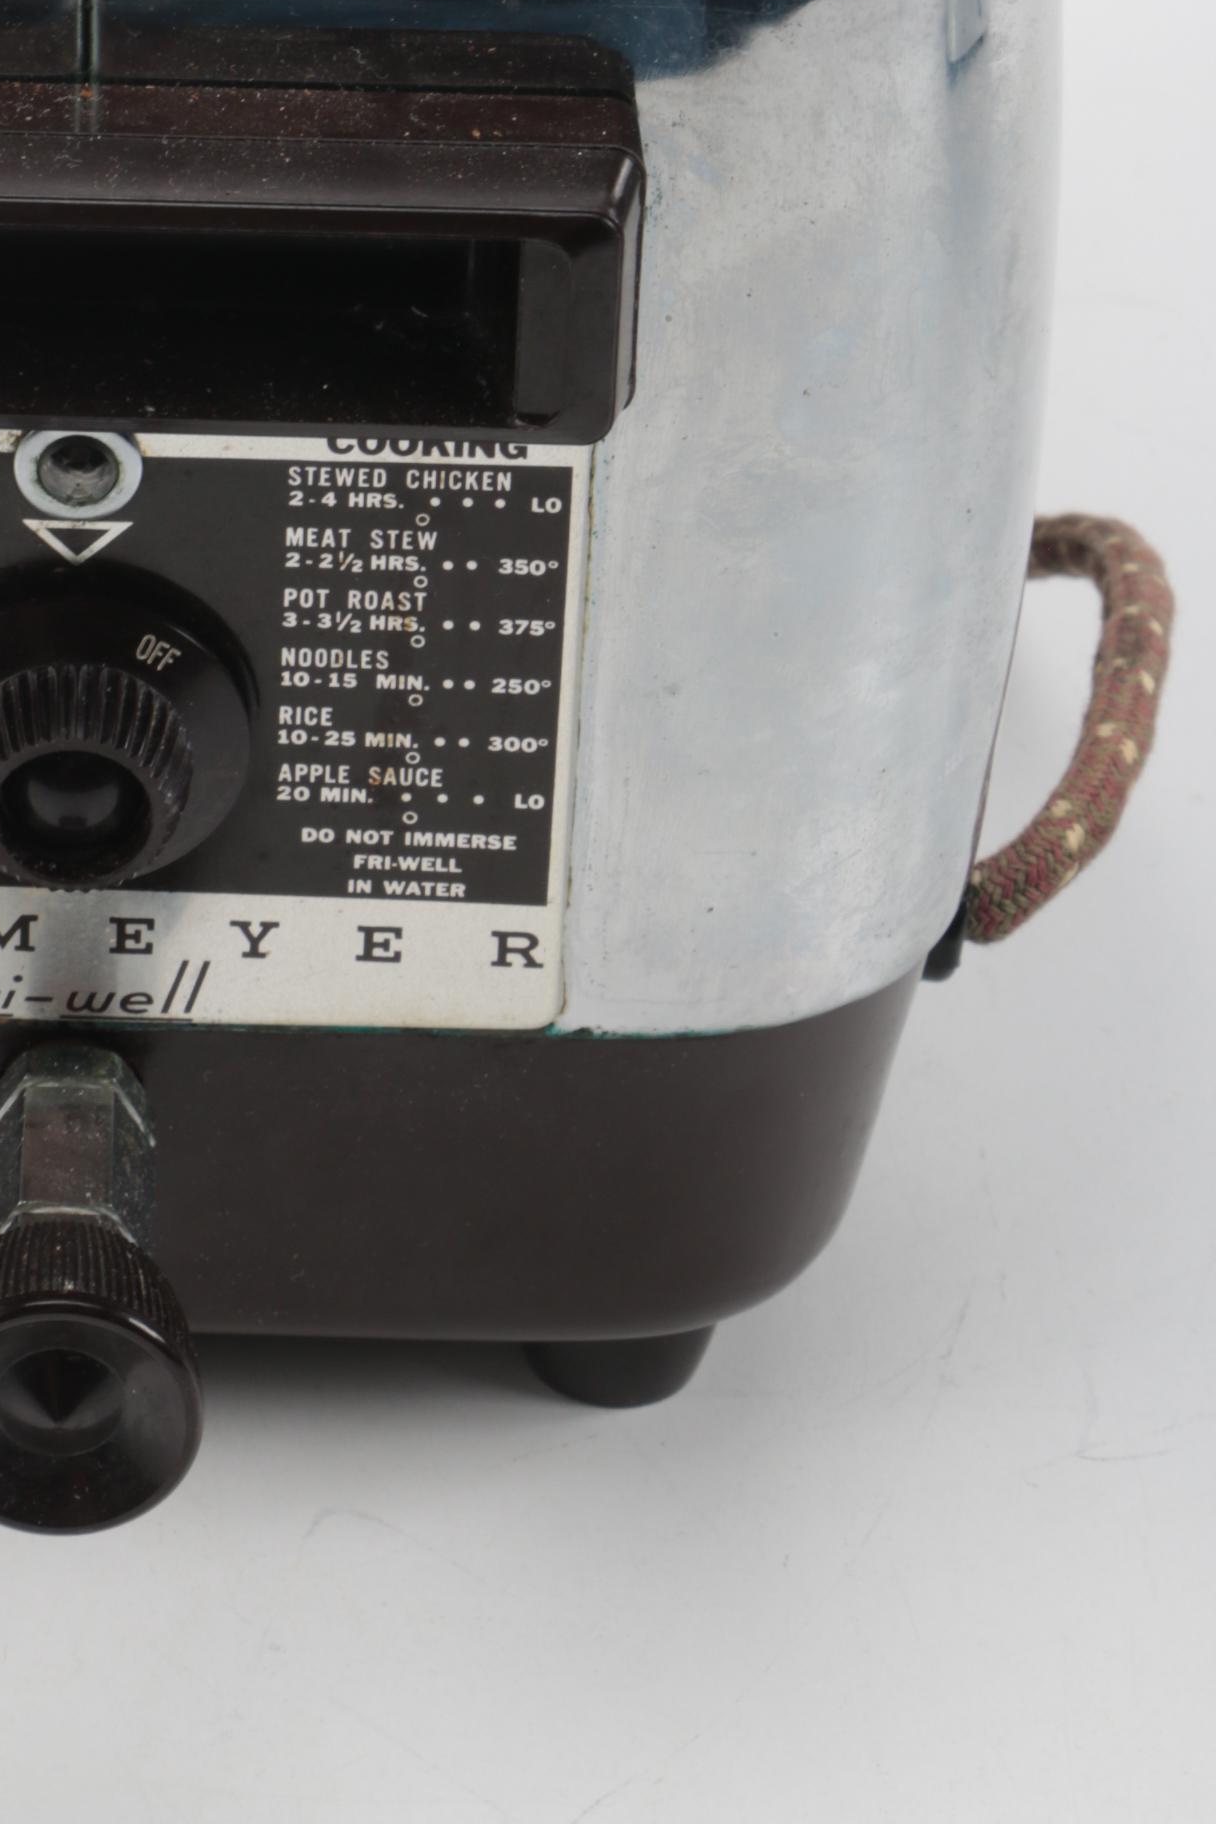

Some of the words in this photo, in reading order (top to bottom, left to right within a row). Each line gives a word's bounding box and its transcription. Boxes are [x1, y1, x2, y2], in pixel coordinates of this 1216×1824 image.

[288, 466, 386, 487] STEWED
[407, 470, 511, 491] CHICKEN
[289, 491, 336, 506] 2-4
[349, 492, 403, 508] HRS.
[532, 498, 562, 513] LO
[286, 527, 351, 547] MEAT
[371, 530, 437, 550] STEW
[371, 555, 426, 571] HRS.
[499, 559, 558, 576] 350°
[284, 588, 329, 608] POT
[348, 590, 426, 611] ROAST
[370, 615, 425, 632] HRS.
[499, 619, 555, 636] 375°
[136, 634, 182, 671] OFF
[282, 648, 388, 669] NOODLES
[281, 671, 357, 688] 10-15
[376, 674, 429, 690] MIN.
[492, 678, 551, 694] 250°
[279, 706, 332, 726] RICE
[278, 729, 355, 746] 10-25
[365, 732, 418, 748] MIN.
[488, 737, 548, 752] 300°
[279, 764, 349, 784] APPLE
[369, 767, 442, 787] SAUCE
[277, 786, 310, 801] 20
[321, 787, 372, 803] MIN.
[515, 794, 544, 809] LO
[302, 828, 334, 843] DO
[346, 830, 393, 845] NOT
[405, 832, 516, 850] IMMERSE
[354, 854, 462, 872] FRI-WELL
[348, 880, 371, 893] IN
[384, 881, 466, 897] WATER
